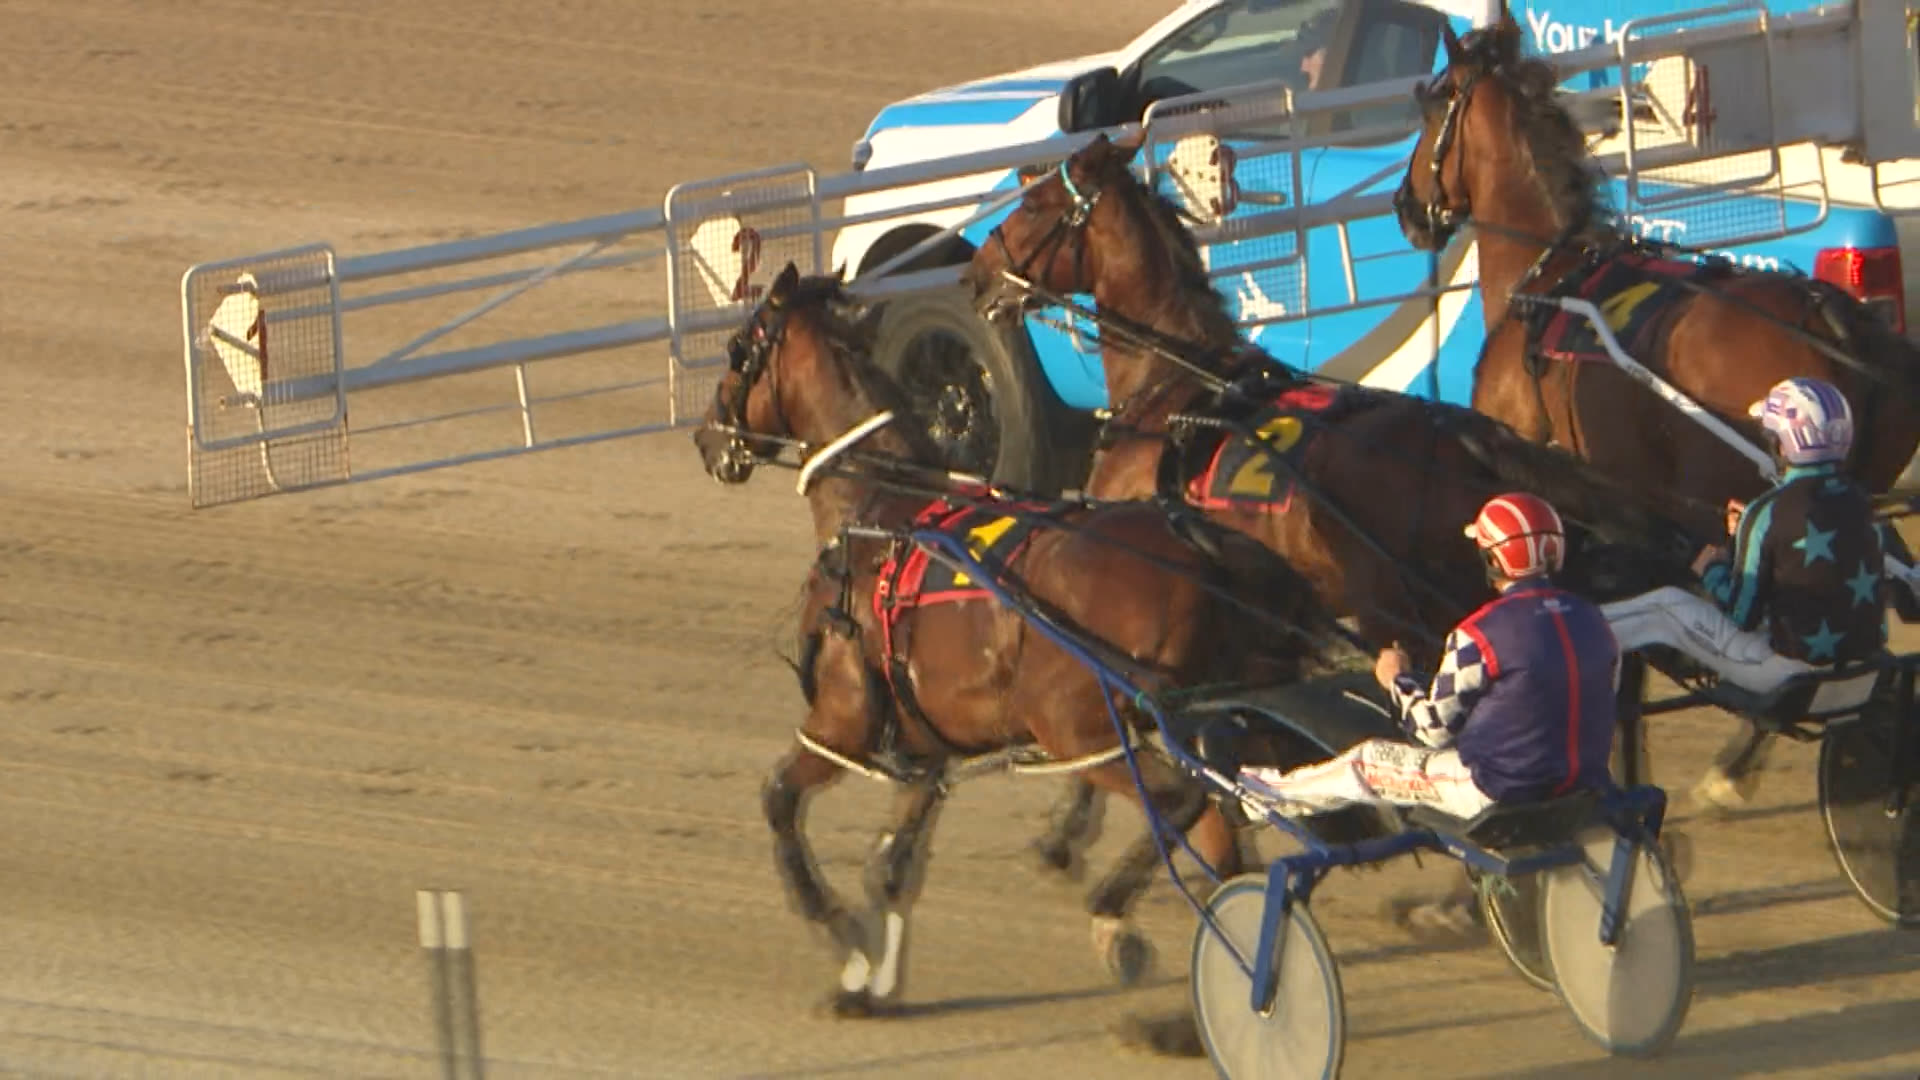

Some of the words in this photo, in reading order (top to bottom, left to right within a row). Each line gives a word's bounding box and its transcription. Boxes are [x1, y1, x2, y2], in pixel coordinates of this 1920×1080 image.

[732, 227, 766, 301] 2
[248, 309, 268, 380] 1
[1230, 416, 1303, 496] 2
